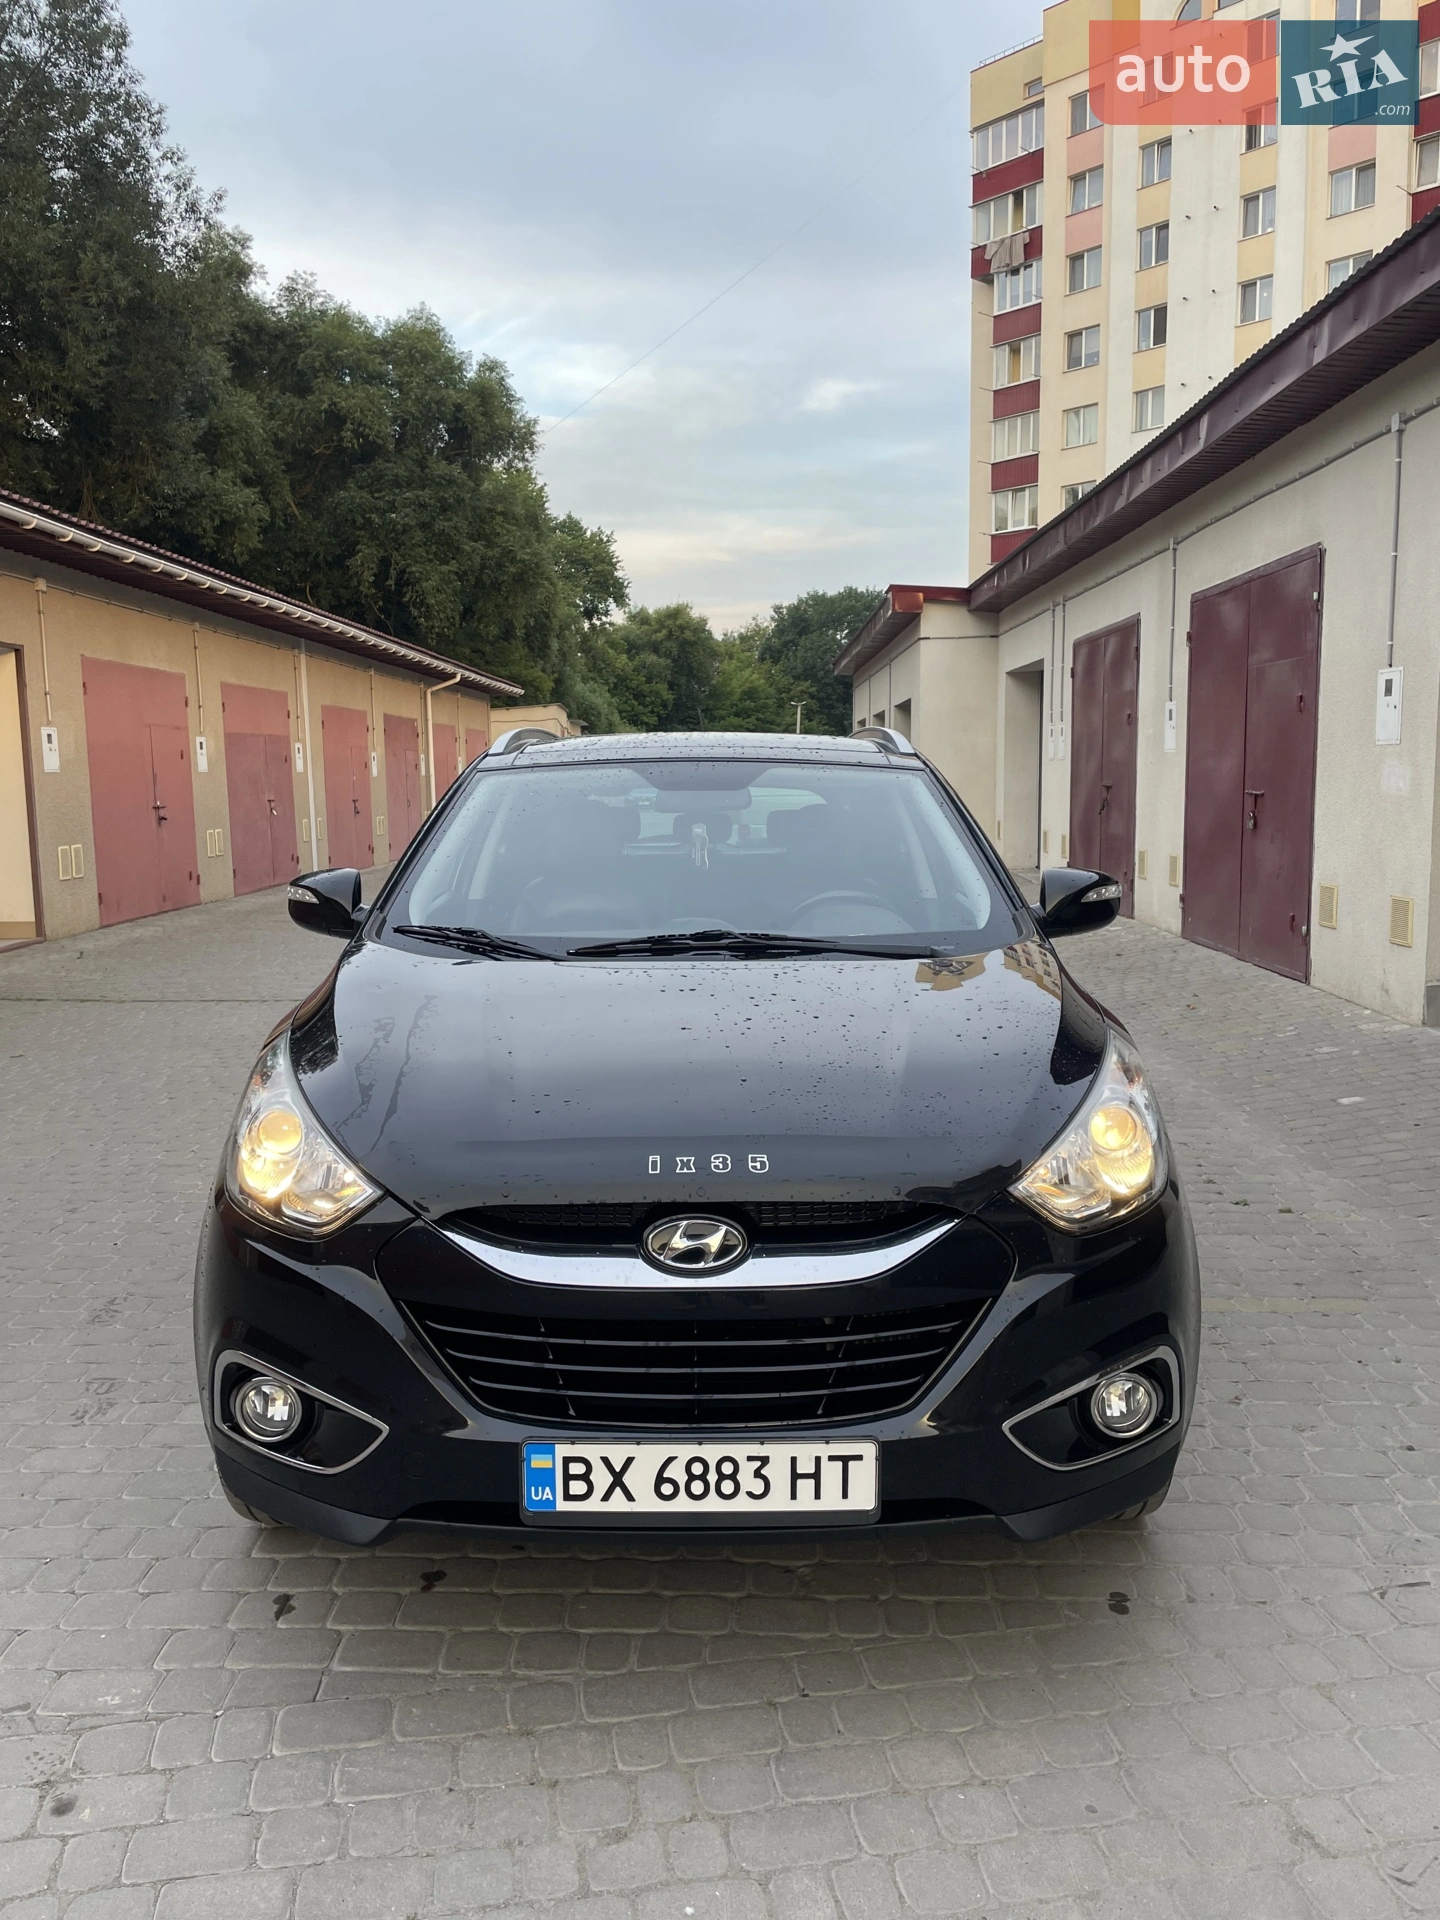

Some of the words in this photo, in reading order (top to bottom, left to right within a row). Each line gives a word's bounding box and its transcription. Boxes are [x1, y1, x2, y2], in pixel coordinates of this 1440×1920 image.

[530, 1486, 554, 1502] UA
[562, 1456, 636, 1502] BX
[653, 1455, 772, 1501] 6883
[789, 1454, 864, 1501] HT
